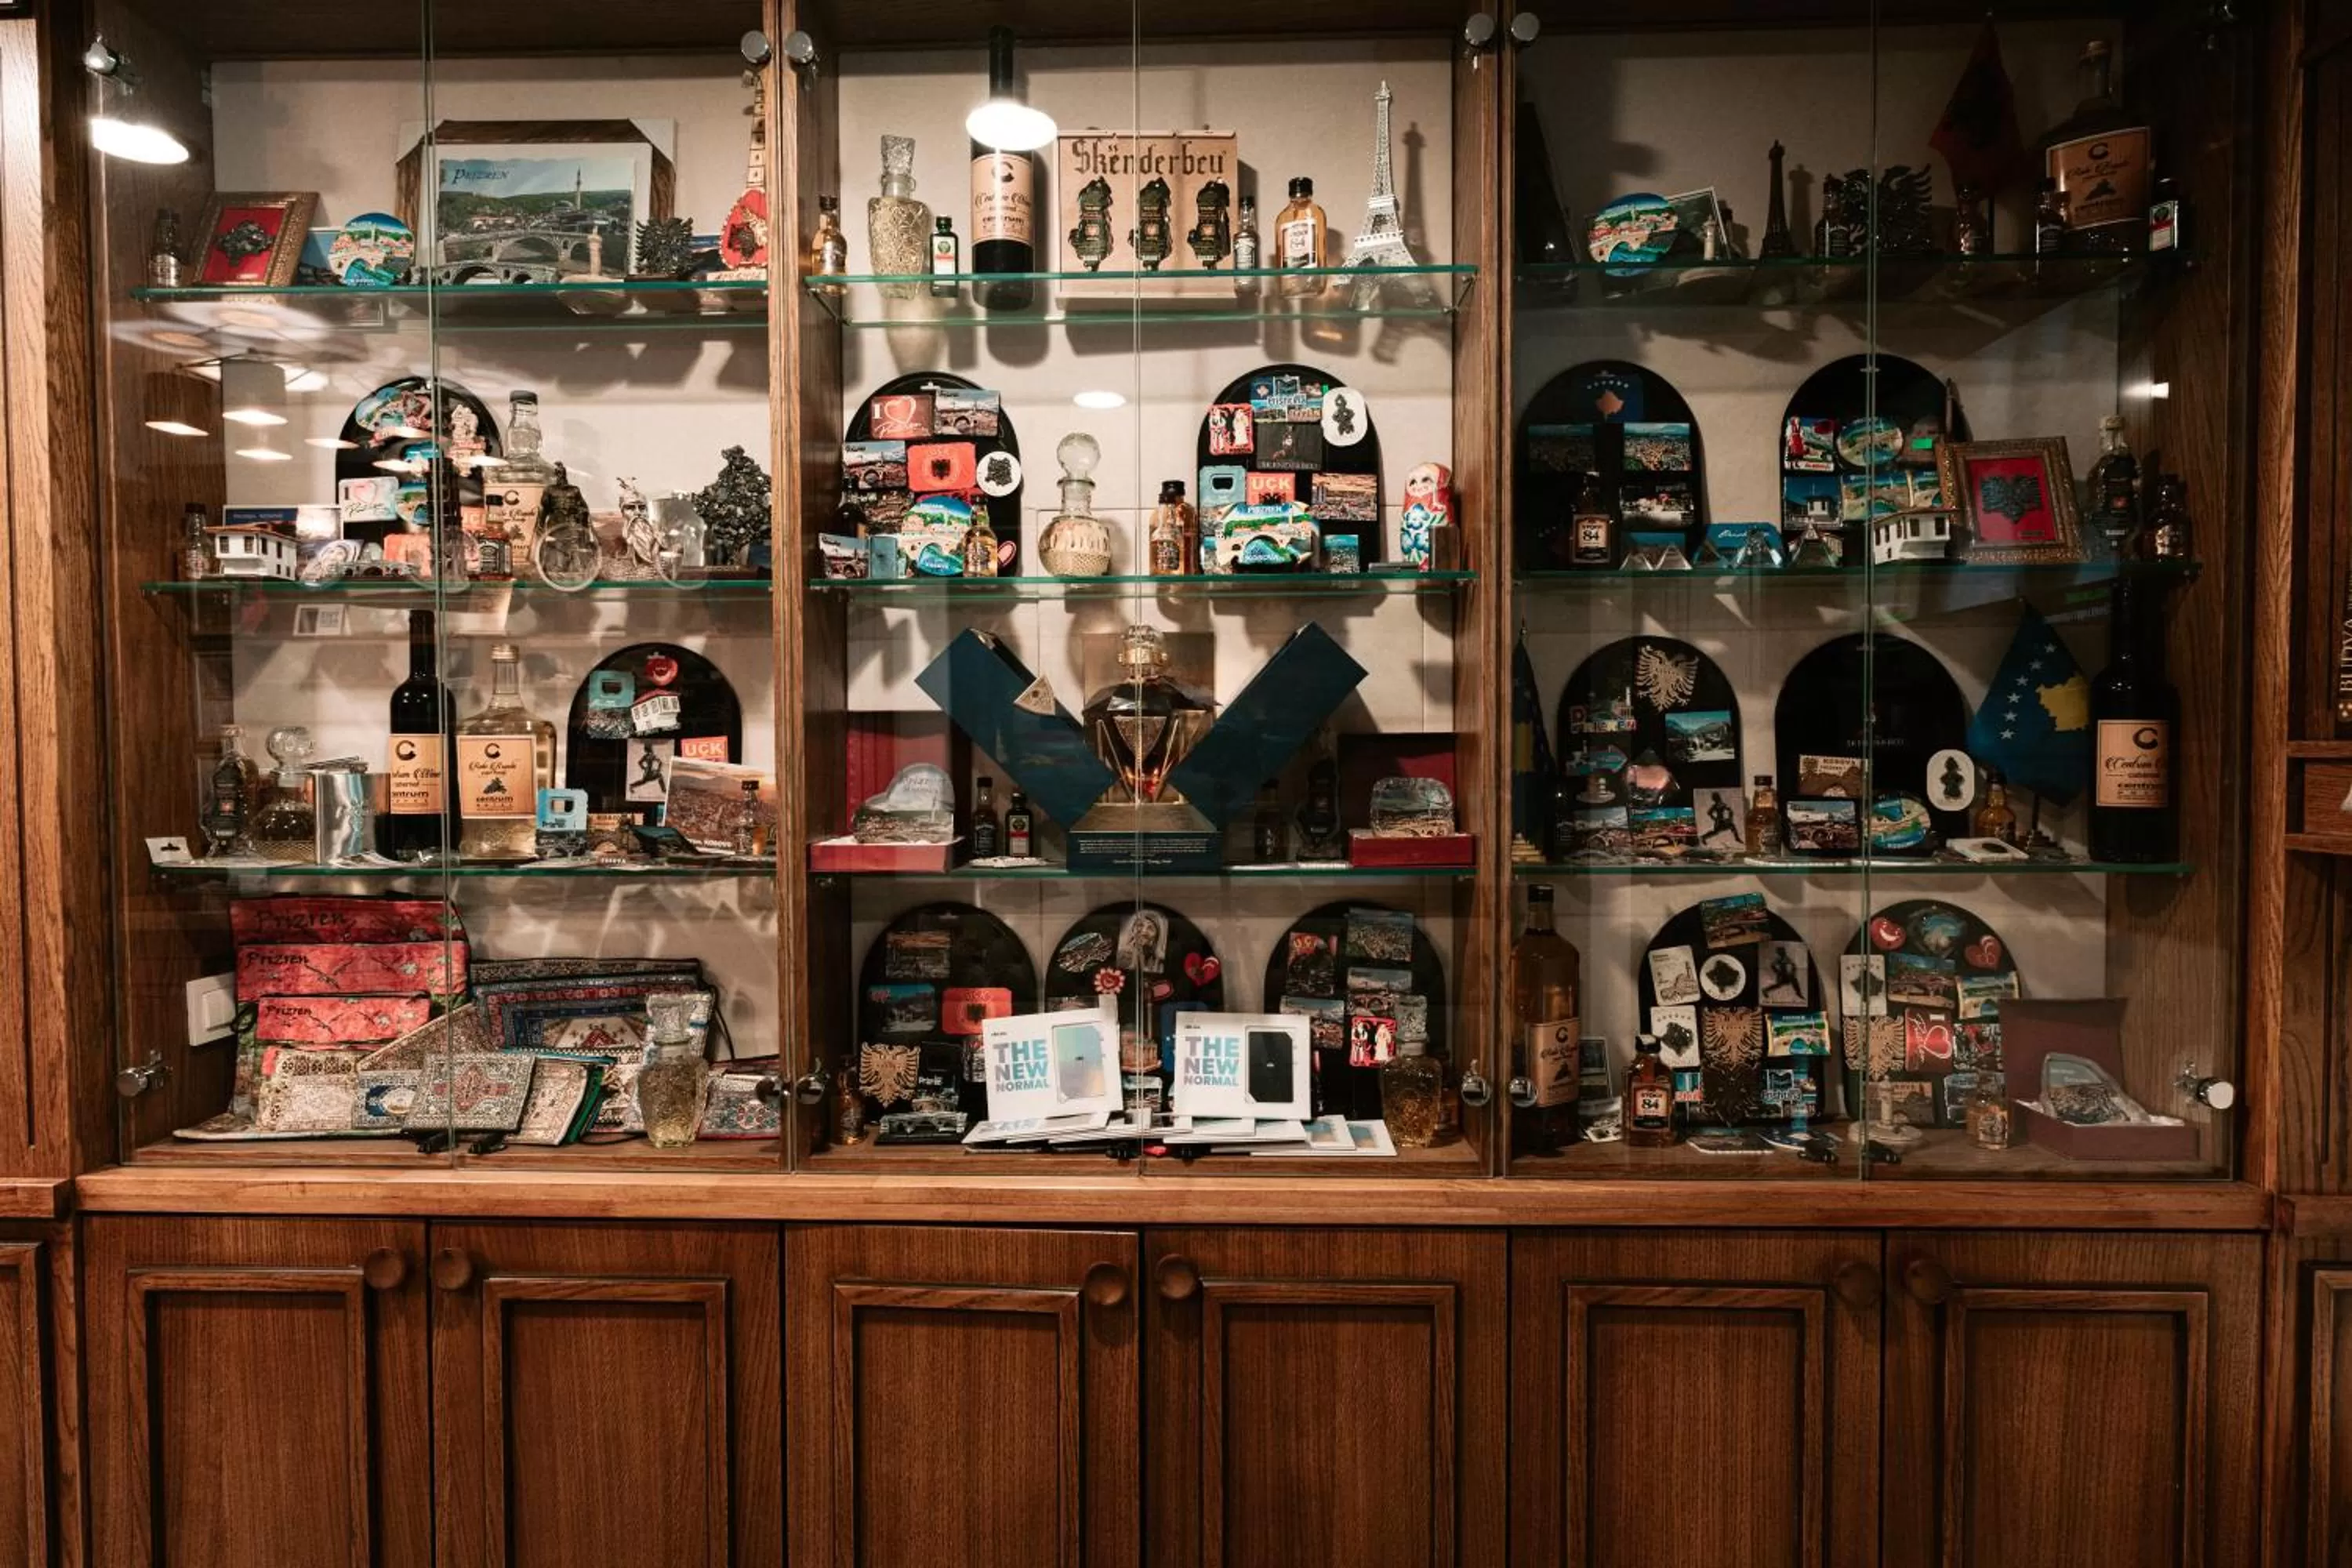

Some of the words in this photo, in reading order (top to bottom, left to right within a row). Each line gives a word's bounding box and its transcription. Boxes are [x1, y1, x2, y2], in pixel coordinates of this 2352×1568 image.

[1072, 137, 1226, 175] Skënderbeu
[1583, 530, 1599, 541] 84
[256, 909, 348, 932] Prizren
[246, 951, 309, 969] Prizren
[266, 1004, 313, 1018] Prizren
[993, 1039, 1047, 1063] THE
[1185, 1036, 1240, 1057] THE
[995, 1061, 1048, 1080] NEW
[1185, 1058, 1239, 1074] NEW
[996, 1079, 1050, 1092] NORMAL
[1184, 1075, 1240, 1087] NORMAL
